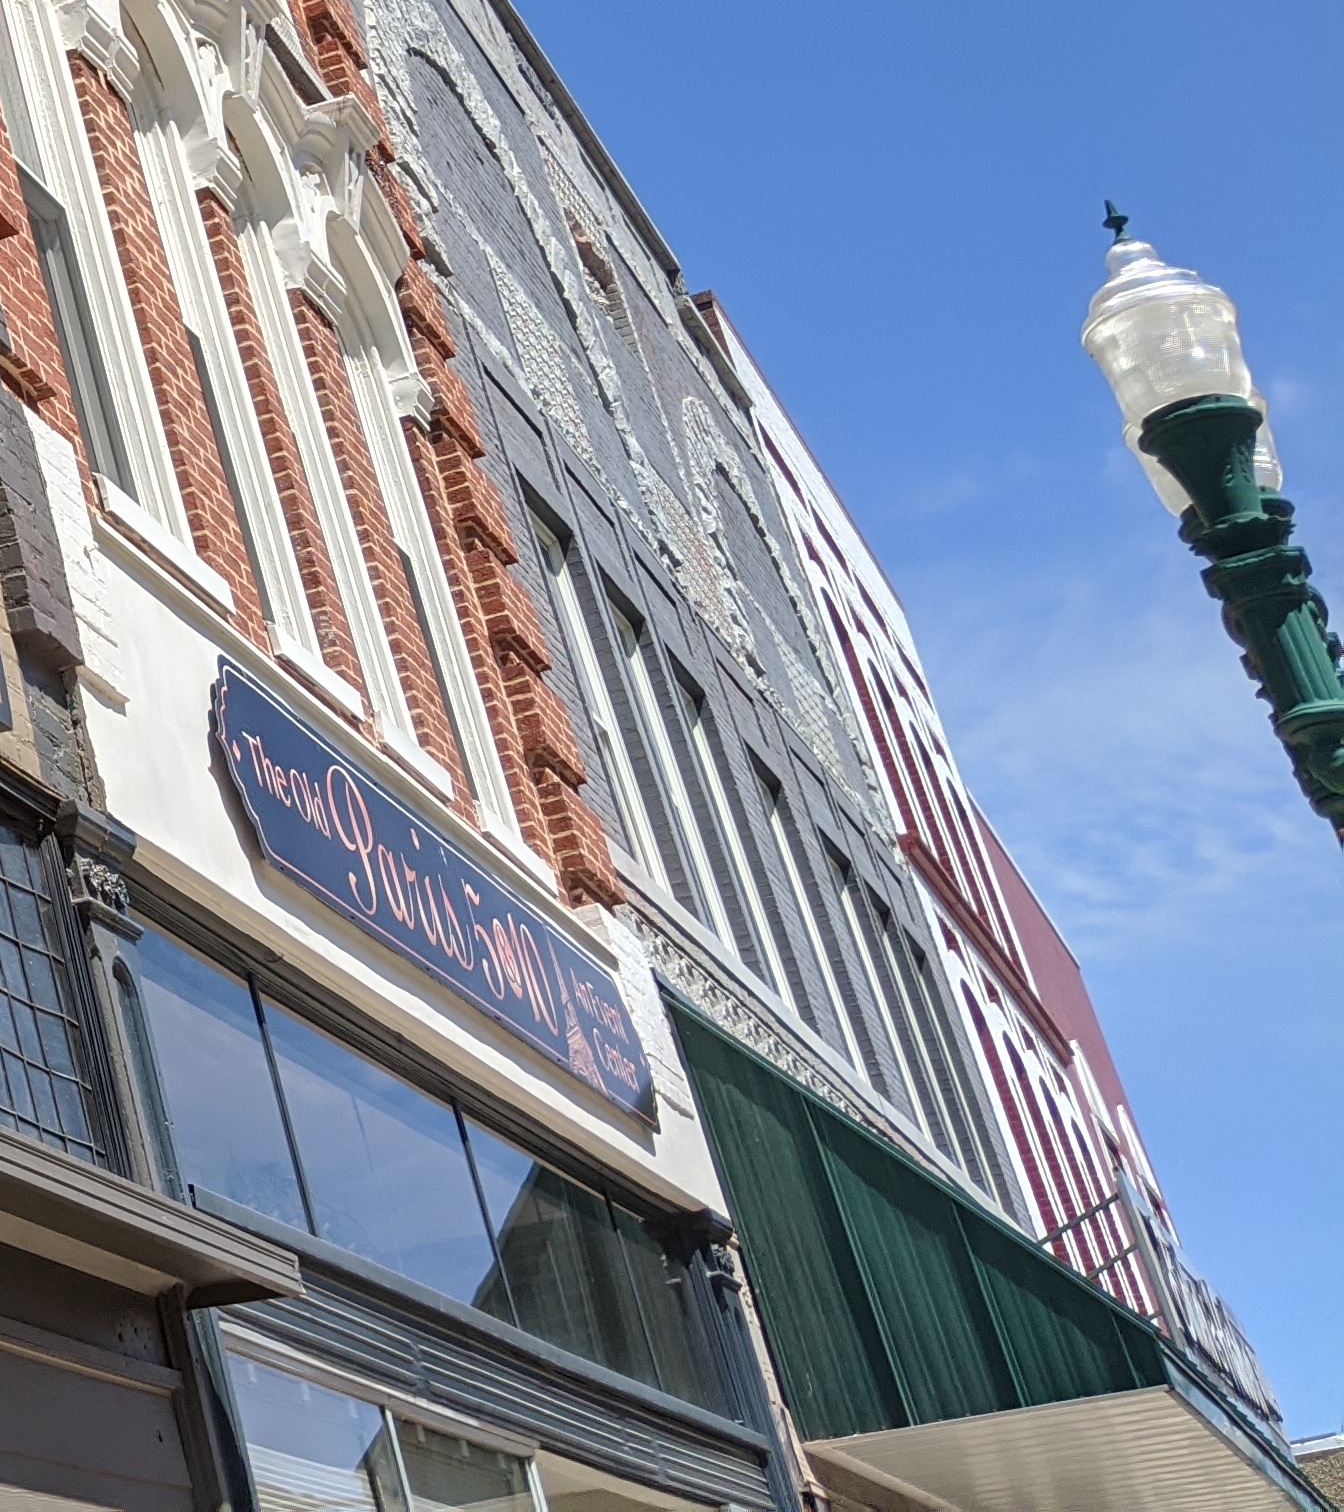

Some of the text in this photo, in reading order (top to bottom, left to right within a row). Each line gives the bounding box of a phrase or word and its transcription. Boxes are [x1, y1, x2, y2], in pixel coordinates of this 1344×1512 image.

[241, 731, 291, 807] The
[290, 768, 332, 839] Old
[326, 764, 474, 972] Paris
[570, 968, 630, 1045] An Event
[593, 1028, 641, 1094] Center
